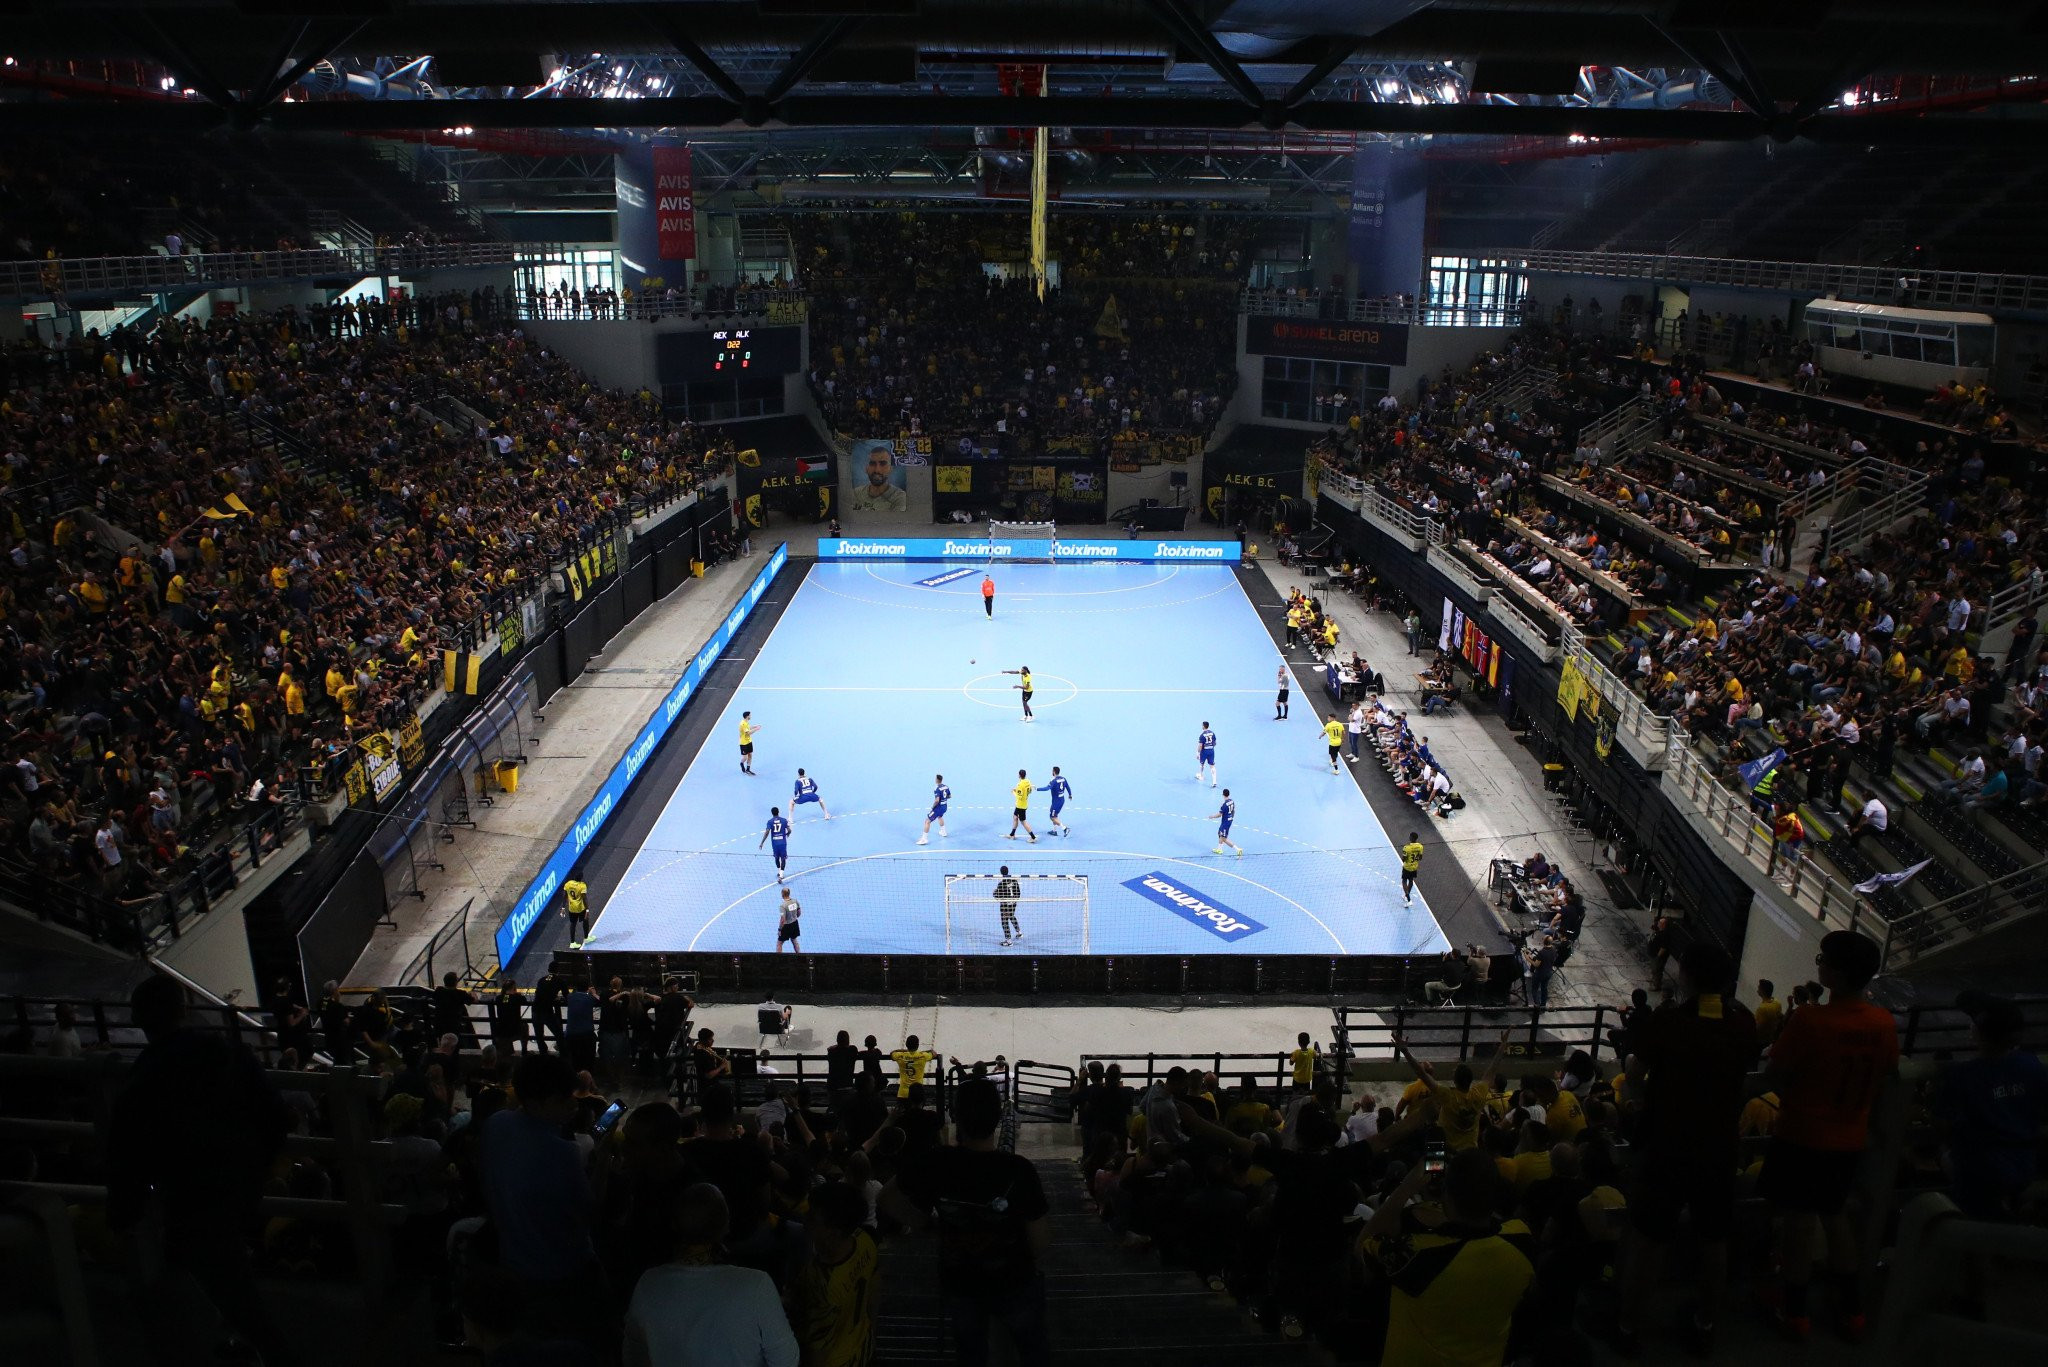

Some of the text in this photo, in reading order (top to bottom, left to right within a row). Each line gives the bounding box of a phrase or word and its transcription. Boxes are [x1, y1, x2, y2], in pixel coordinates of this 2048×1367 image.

[658, 175, 690, 190] AVIS
[659, 197, 691, 211] AVIS
[1353, 203, 1375, 211] Allianz
[660, 218, 692, 232] AVIS
[713, 330, 750, 340] AEK ALK
[1338, 329, 1379, 344] arena
[761, 476, 790, 489] A.E.K.
[1225, 473, 1277, 488] A.E.K. B.C.
[836, 541, 906, 555] Stoiximan
[942, 541, 1012, 555] Stoiximan
[1154, 543, 1223, 557] Stoiximan
[698, 640, 720, 677] Stoiximan
[666, 681, 691, 723] Stoiximan
[1333, 728, 1339, 737] 11
[626, 730, 656, 781] Stoiximan
[575, 792, 612, 854] Stoiximan
[773, 823, 782, 833] 17
[511, 870, 557, 947] Stoiximan
[1142, 875, 1251, 933] Stoiximan
[905, 1060, 916, 1077] 5
